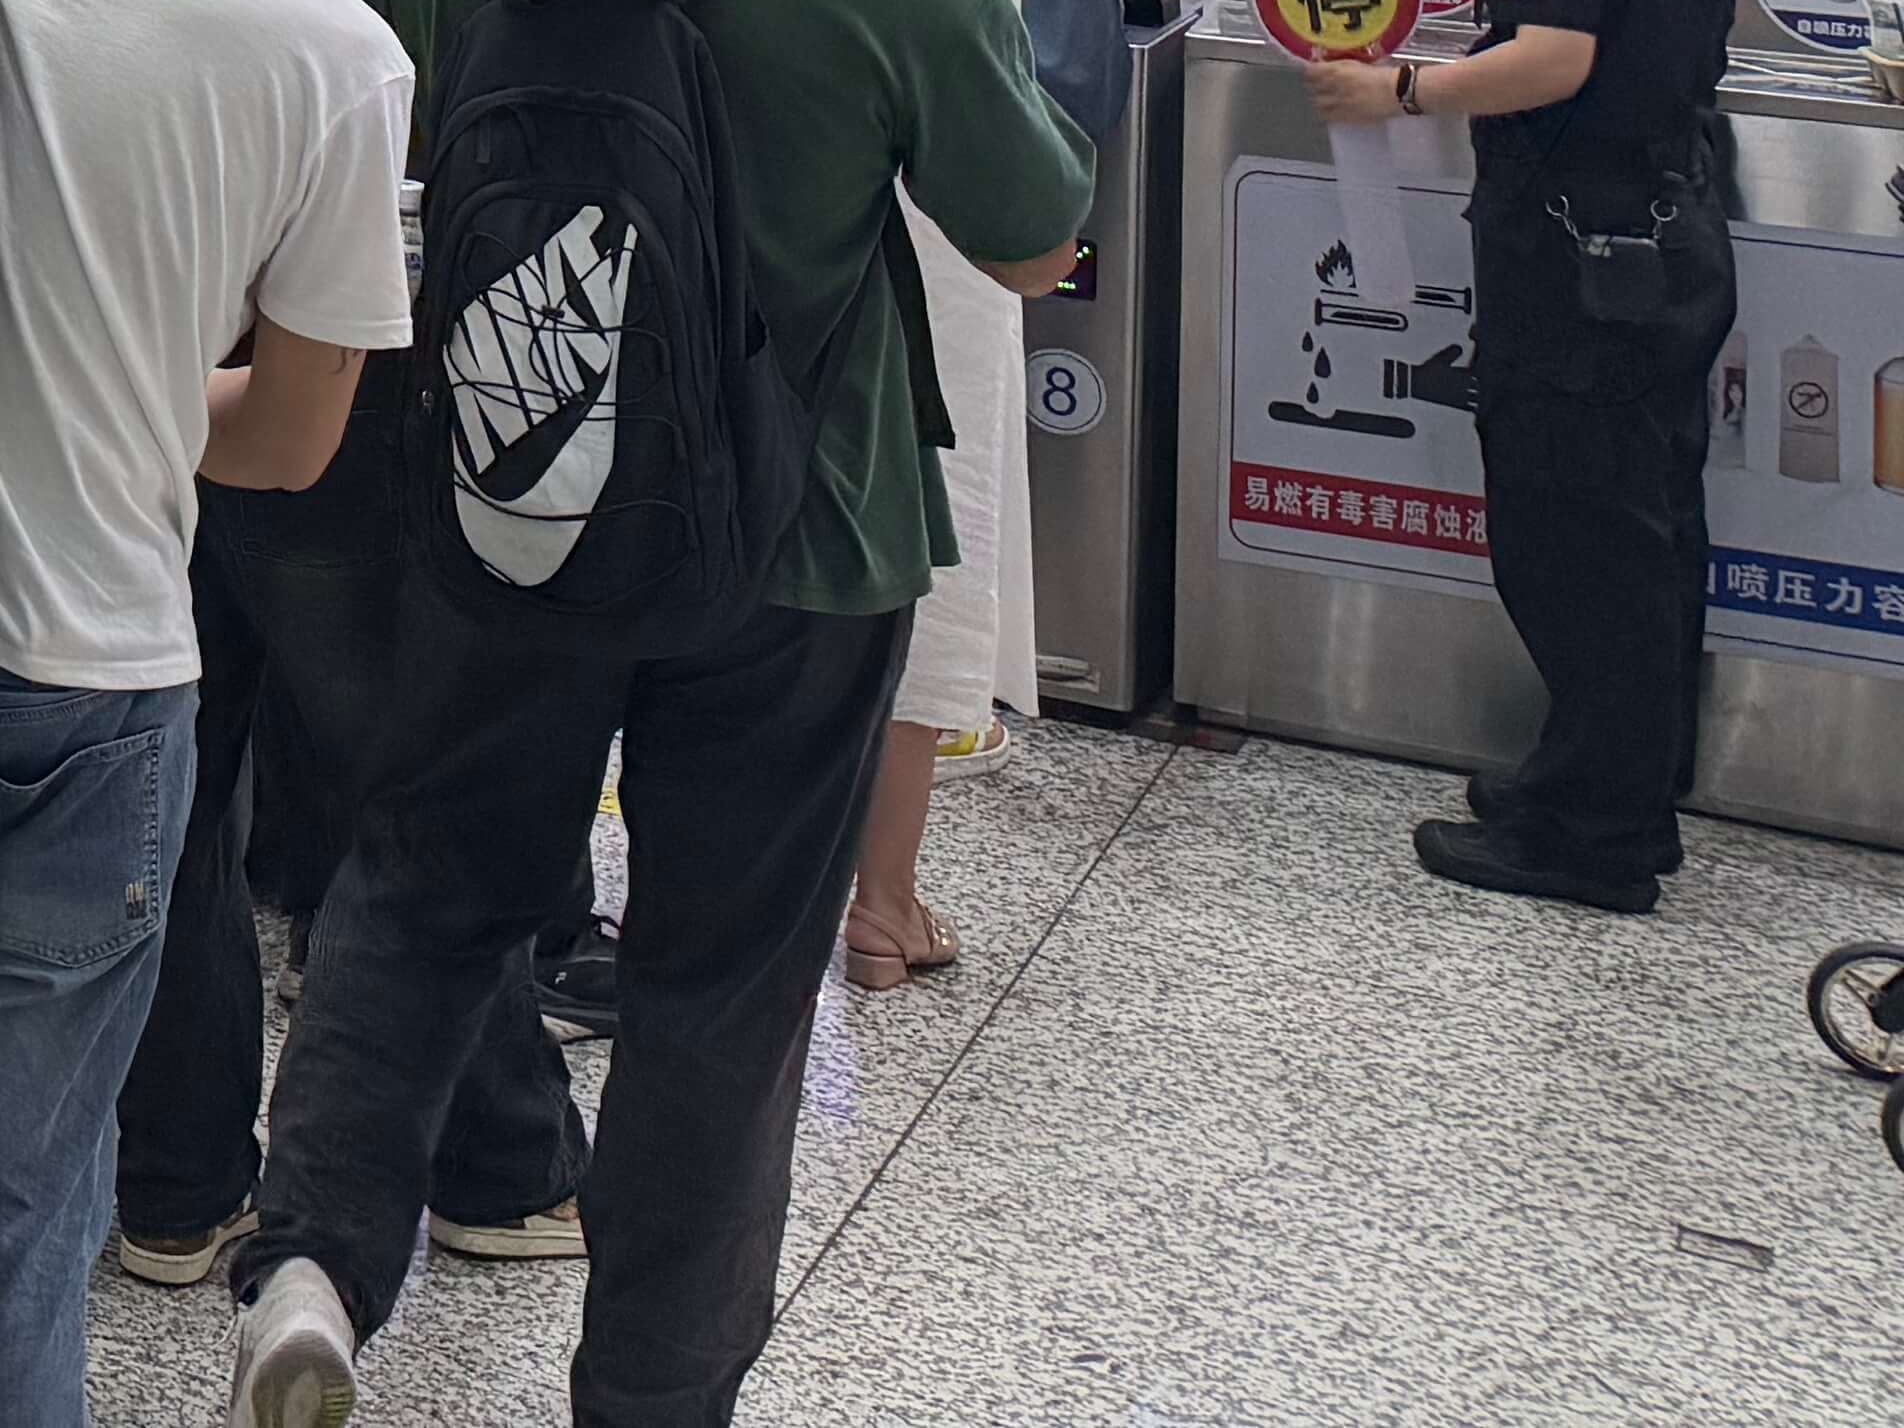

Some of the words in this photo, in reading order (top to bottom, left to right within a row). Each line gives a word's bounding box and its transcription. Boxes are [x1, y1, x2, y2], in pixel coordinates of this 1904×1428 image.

[1043, 366, 1077, 417] 8
[1244, 475, 1489, 544] 易燃有毒害腐蚀液
[1706, 561, 1904, 623] 喷压力容
